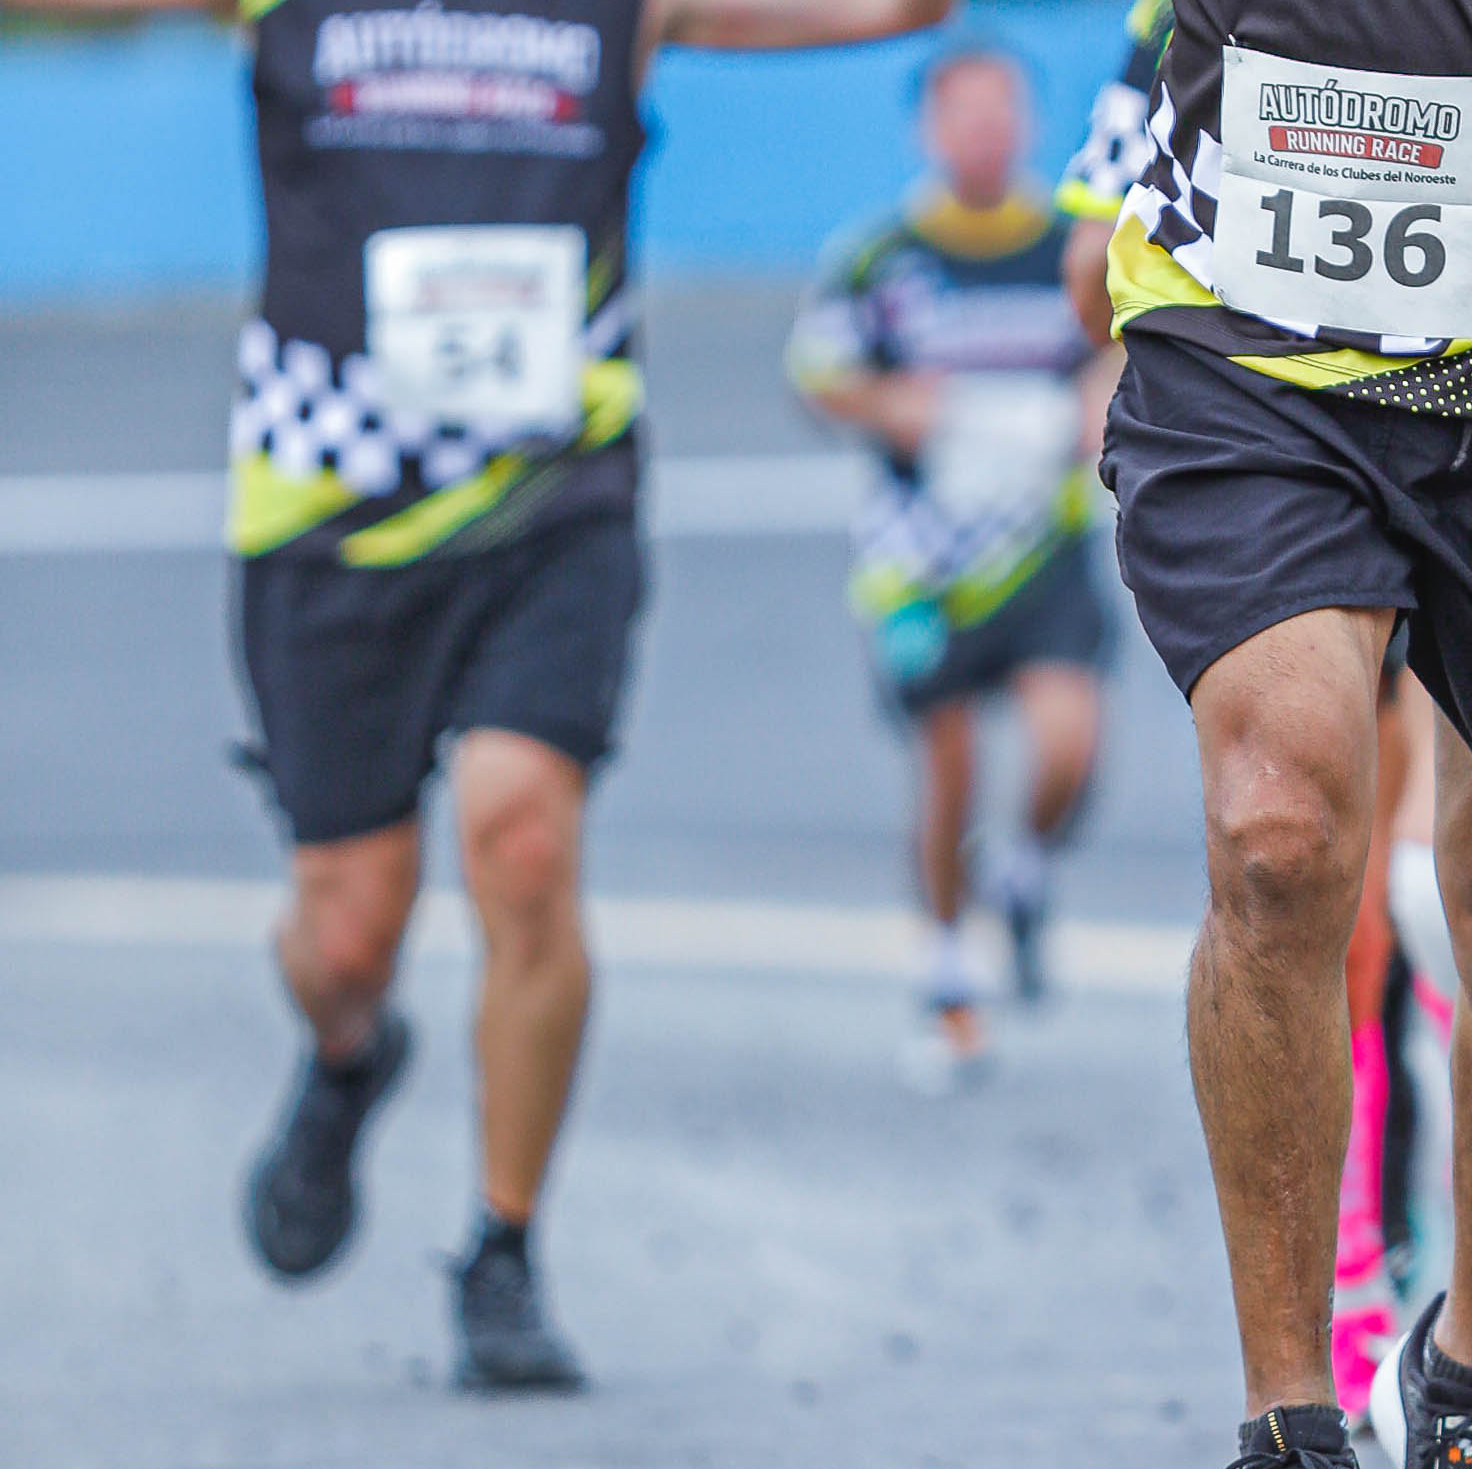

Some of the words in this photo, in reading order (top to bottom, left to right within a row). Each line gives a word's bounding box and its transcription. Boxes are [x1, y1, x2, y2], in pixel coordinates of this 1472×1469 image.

[1259, 79, 1462, 142] AUTÓDROMO
[1254, 151, 1266, 164] La
[1268, 154, 1305, 172] Carrera
[1307, 162, 1321, 175] de
[1323, 164, 1339, 178] los
[1341, 167, 1381, 181] Clubes
[1383, 170, 1402, 182] del
[1405, 172, 1456, 185] Noroeste
[1286, 130, 1366, 155] RUNNING
[1371, 137, 1423, 164] RACE
[1255, 188, 1447, 288] 136
